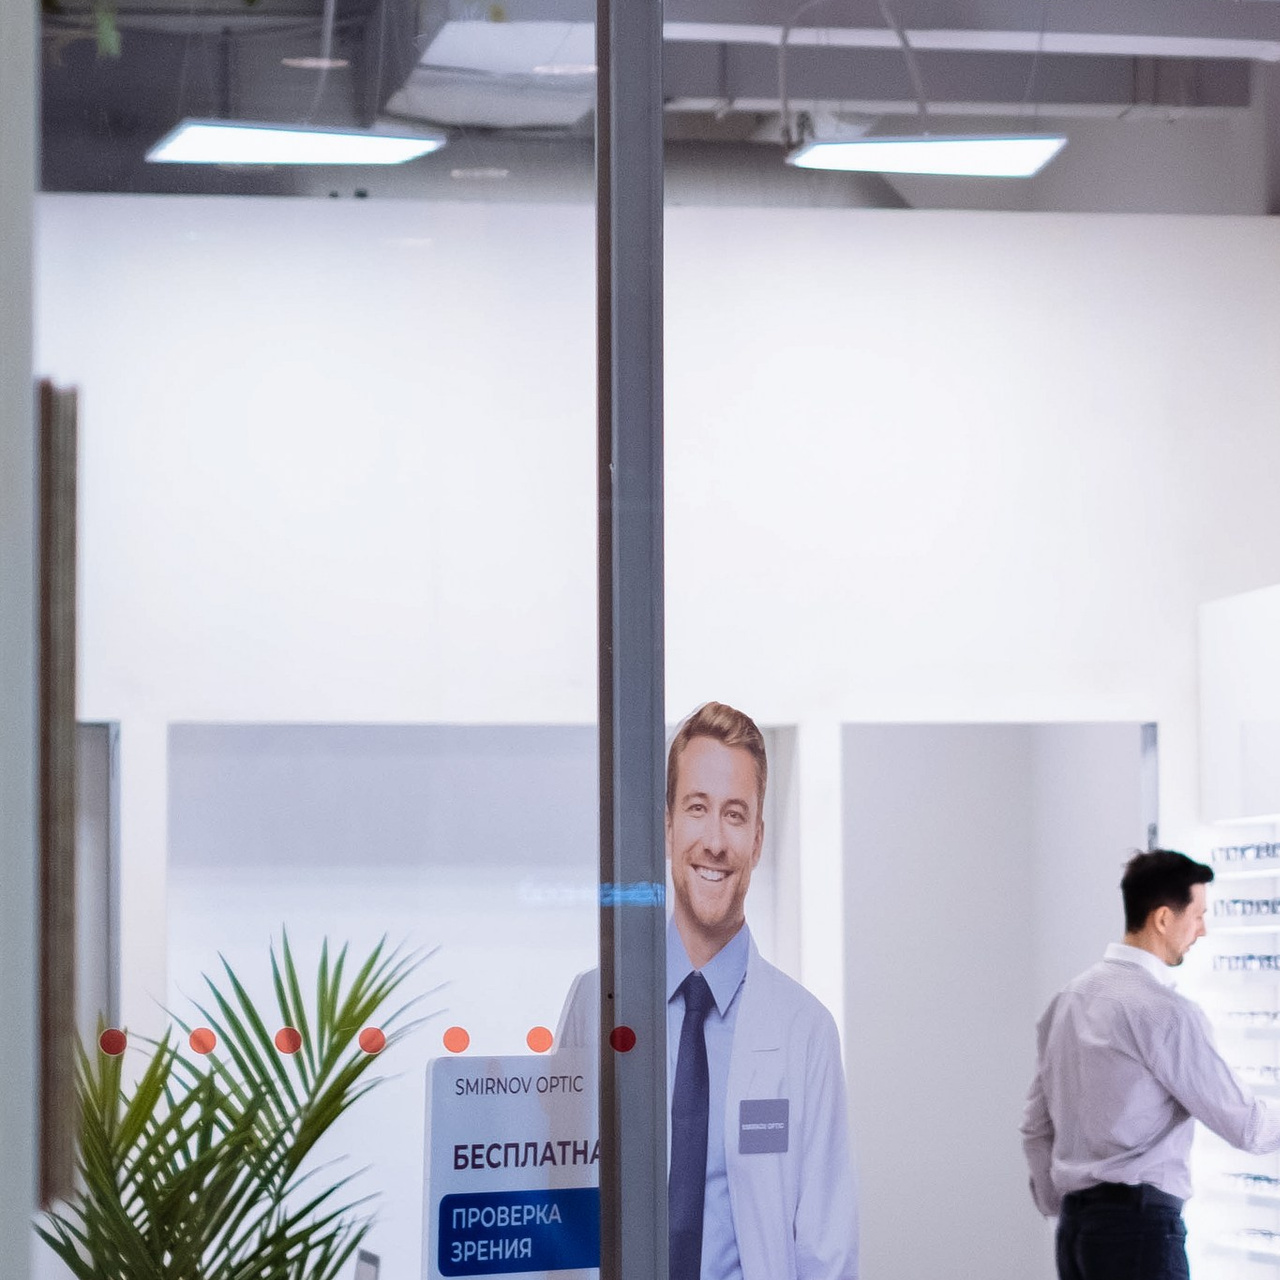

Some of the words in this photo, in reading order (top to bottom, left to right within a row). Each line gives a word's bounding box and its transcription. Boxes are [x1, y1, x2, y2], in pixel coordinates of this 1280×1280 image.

[455, 1077, 533, 1096] SMIRNOV
[536, 1075, 584, 1094] OPTIC
[452, 1203, 563, 1230] ПРОВЕРКА
[450, 1237, 532, 1263] ЗРЕНИЯ
